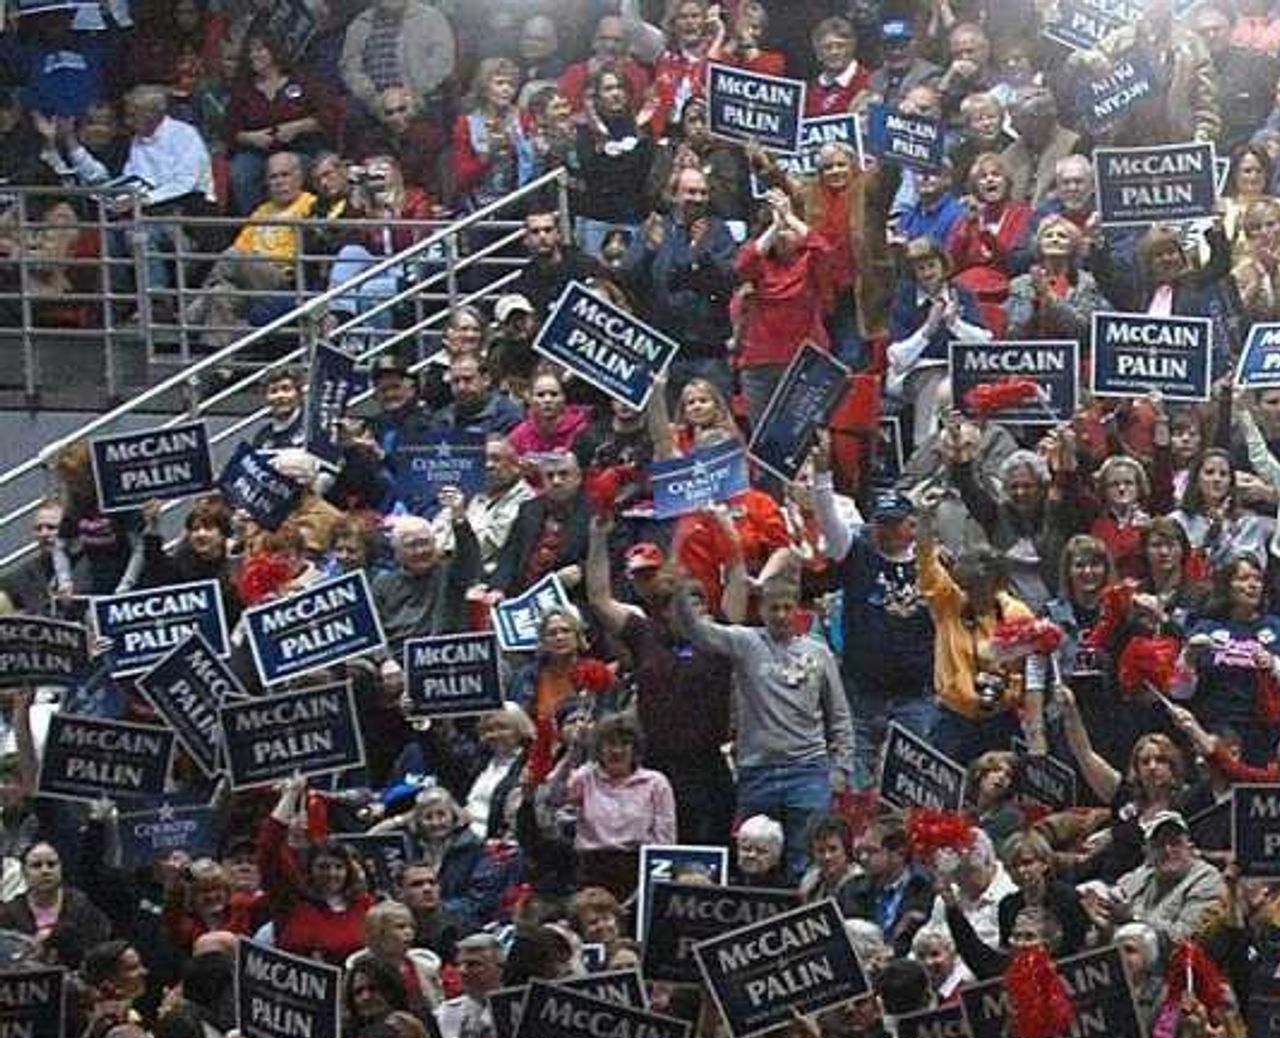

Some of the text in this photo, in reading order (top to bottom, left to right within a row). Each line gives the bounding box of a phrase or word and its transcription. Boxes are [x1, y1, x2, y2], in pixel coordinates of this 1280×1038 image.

[715, 75, 794, 106] McCAIN
[722, 105, 781, 135] PALIN
[800, 121, 850, 146] CAIN
[885, 114, 938, 141] McCAIN
[890, 139, 931, 161] PALIN
[1108, 152, 1202, 177] McCAIN
[1122, 182, 1193, 207] PALIN
[570, 296, 663, 364] McCAIN
[1105, 322, 1199, 348] McCAIN
[566, 329, 637, 382] PALIN
[963, 349, 1065, 372] McCAIN
[1117, 354, 1188, 379] PALIN
[105, 430, 199, 462] McCAIN
[120, 462, 192, 491] PALIN
[107, 590, 209, 625] McCAIN
[260, 582, 358, 634] McCAIN
[0, 624, 79, 648] cCAIN
[280, 616, 357, 660] PALIN
[1, 651, 72, 674] PALIN
[413, 637, 490, 669] McCAIN
[422, 673, 482, 700] PALIN
[235, 692, 341, 732] McCAIN
[60, 725, 162, 757] McCAIN
[253, 728, 333, 764] PALIN
[65, 756, 145, 788] PALIN
[899, 736, 964, 794] McCAIN
[717, 910, 834, 974] McCAIN
[246, 951, 329, 1002] McCAIN
[745, 957, 835, 1006] PALIN
[251, 999, 314, 1038] PALIN
